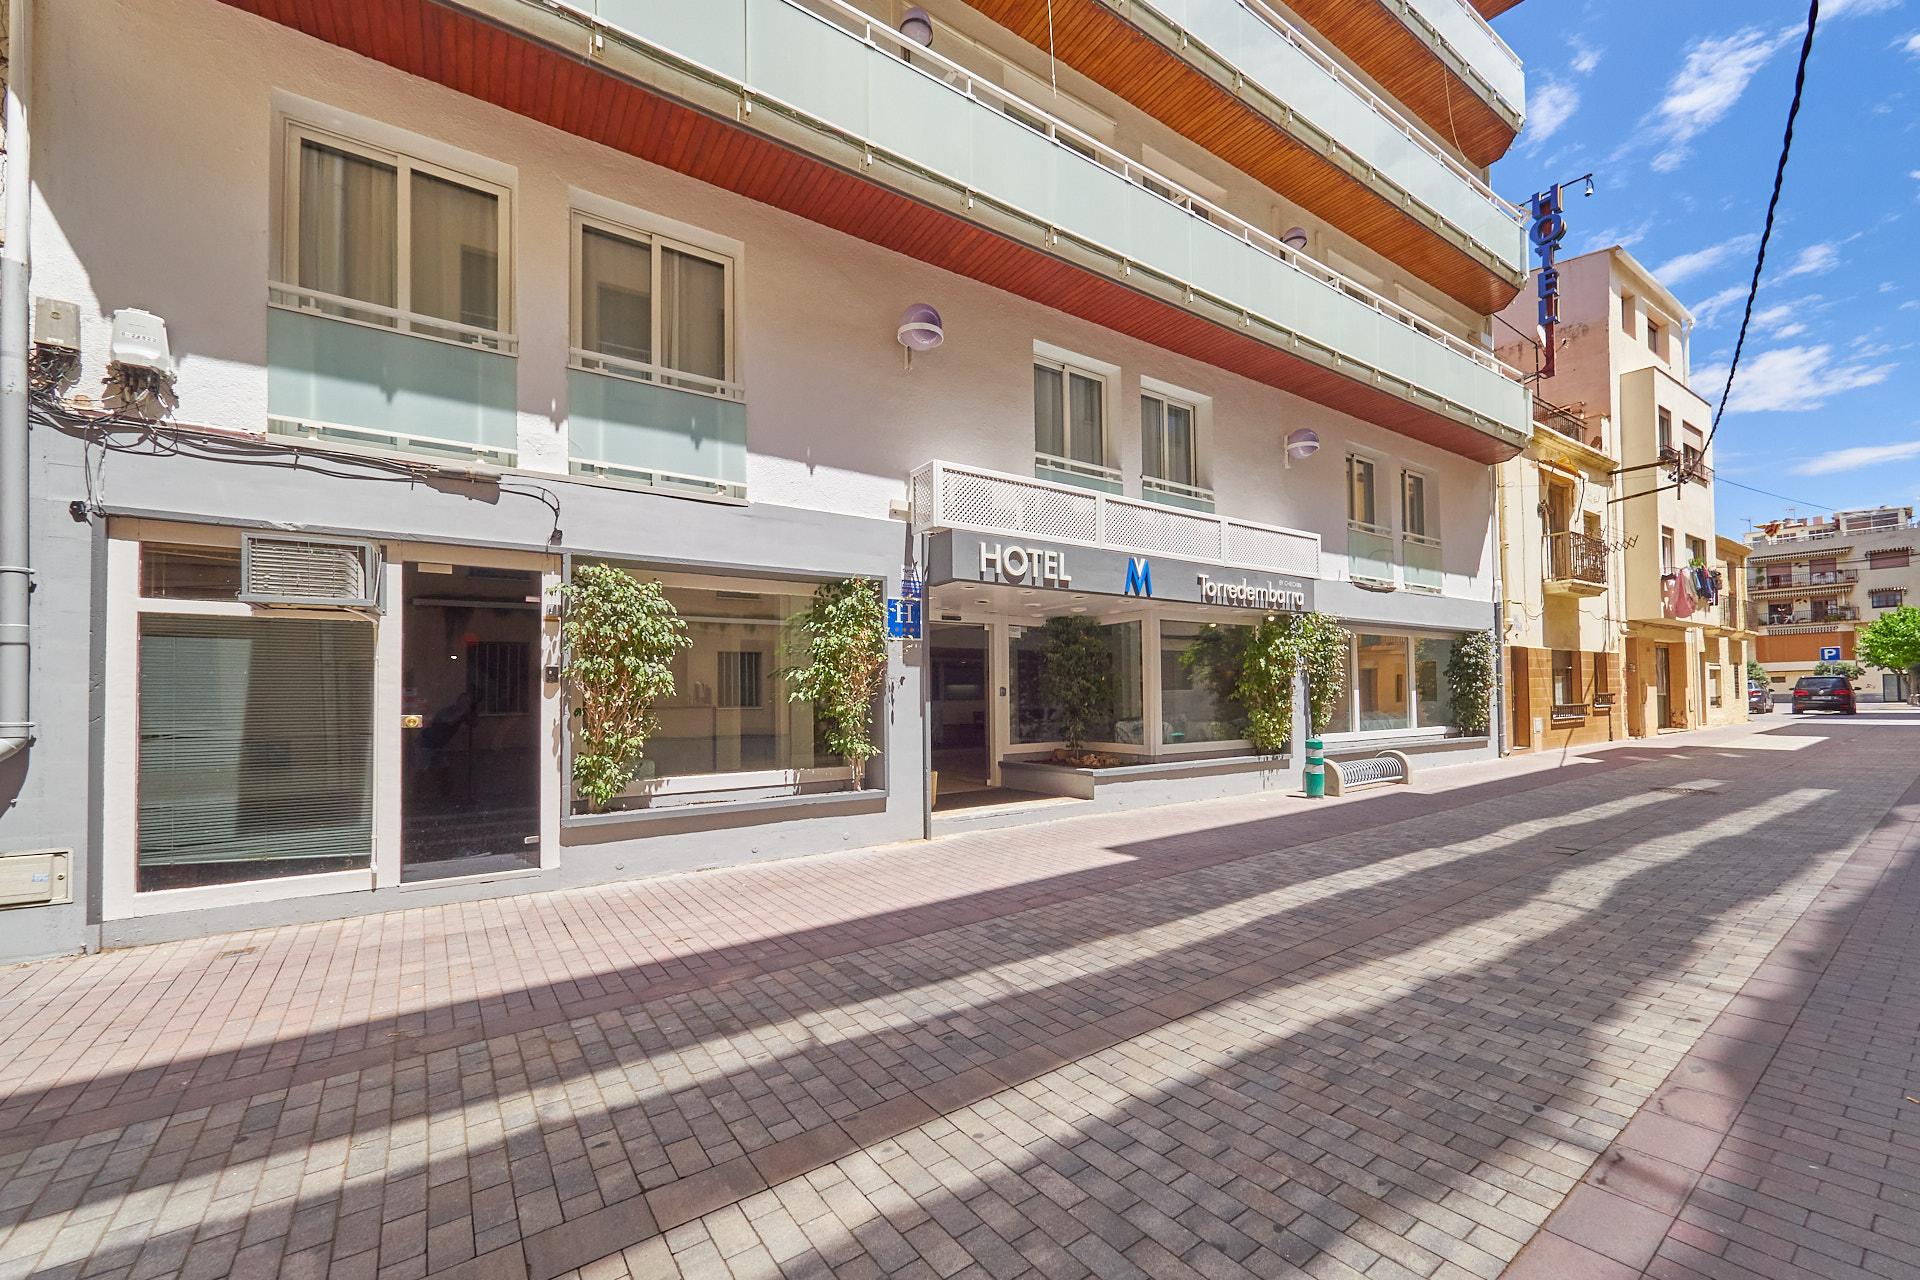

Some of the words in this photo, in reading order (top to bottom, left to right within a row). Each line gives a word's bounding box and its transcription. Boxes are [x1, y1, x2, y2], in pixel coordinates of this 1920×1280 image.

[1530, 183, 1566, 325] HOTEL
[979, 541, 1072, 581] HOTEL
[1197, 573, 1305, 605] Torredembarra
[895, 603, 914, 624] H
[1823, 648, 1837, 660] P
